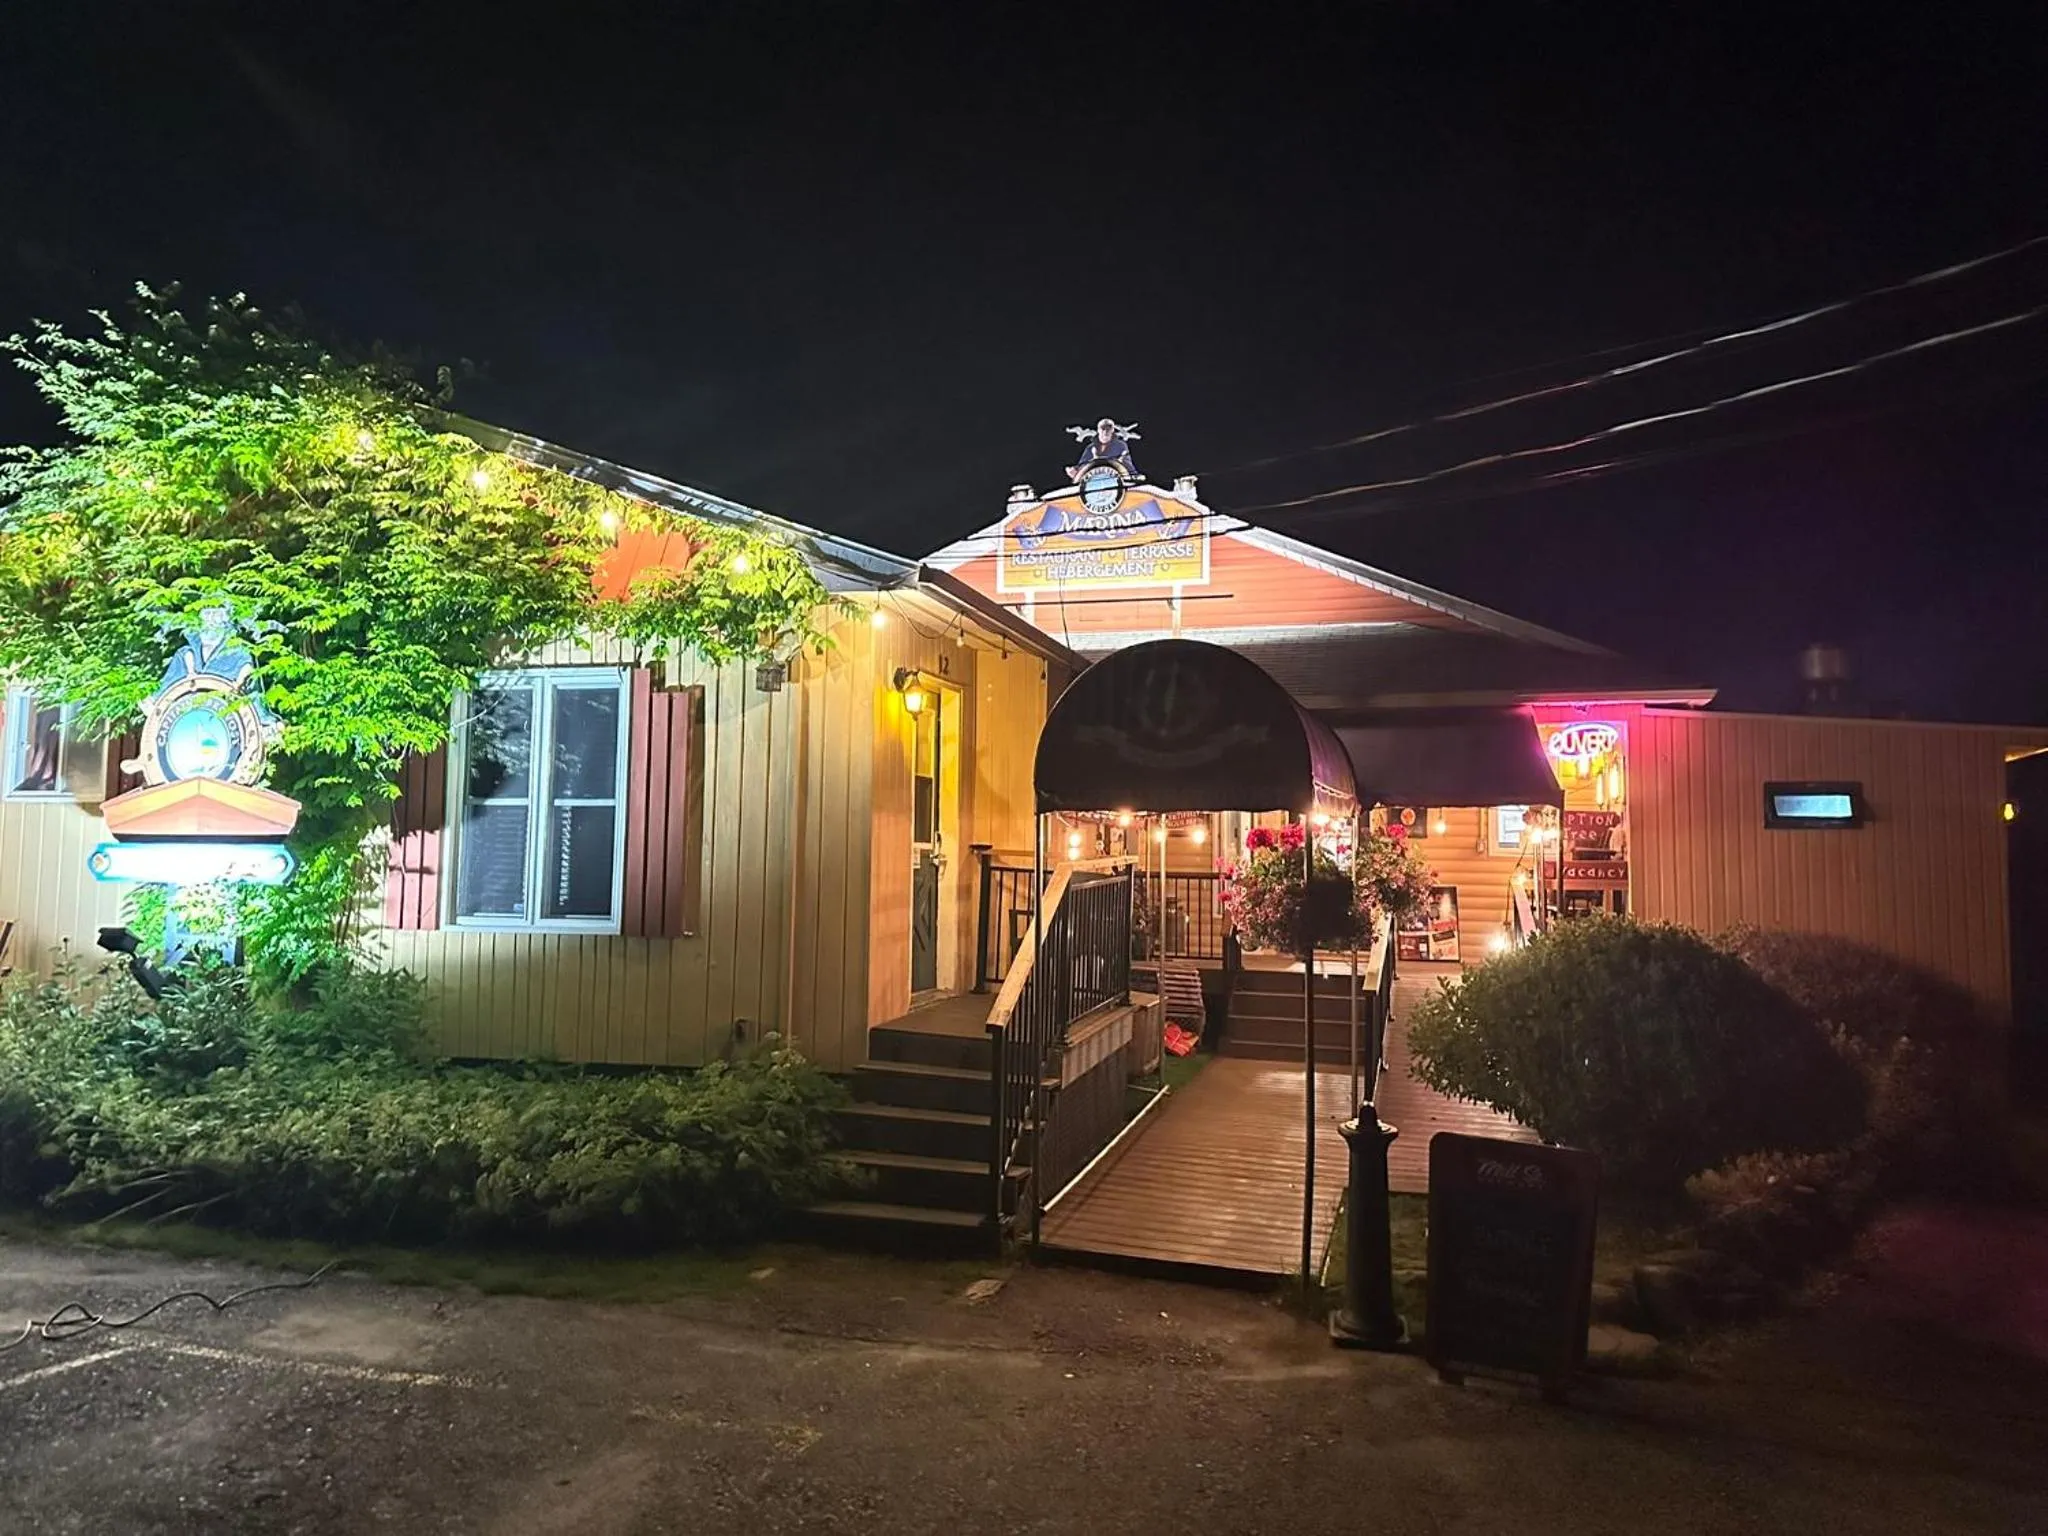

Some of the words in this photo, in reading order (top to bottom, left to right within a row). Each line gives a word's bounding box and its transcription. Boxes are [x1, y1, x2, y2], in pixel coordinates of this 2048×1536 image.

[1011, 549, 1103, 567] RESTAURANT
[1124, 543, 1194, 561] TERRASSE
[939, 654, 949, 675] 12
